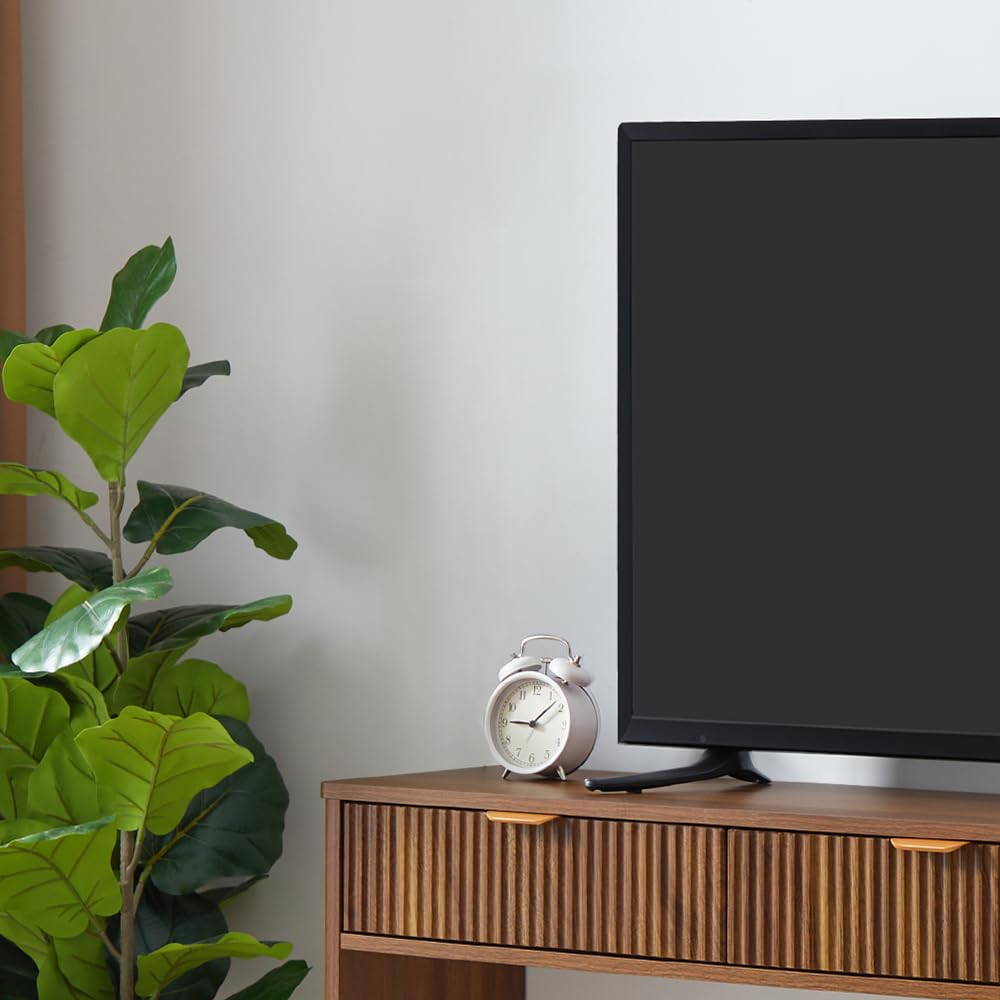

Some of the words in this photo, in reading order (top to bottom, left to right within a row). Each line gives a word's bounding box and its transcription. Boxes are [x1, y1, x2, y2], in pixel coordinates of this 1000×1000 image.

[520, 690, 526, 701] 11
[533, 685, 542, 696] 12
[509, 702, 516, 713] 10
[558, 703, 564, 713] 2
[502, 718, 508, 728] 9
[506, 736, 511, 744] 8
[516, 748, 522, 758] 7
[529, 753, 535, 763] 6
[544, 750, 550, 760] 5
